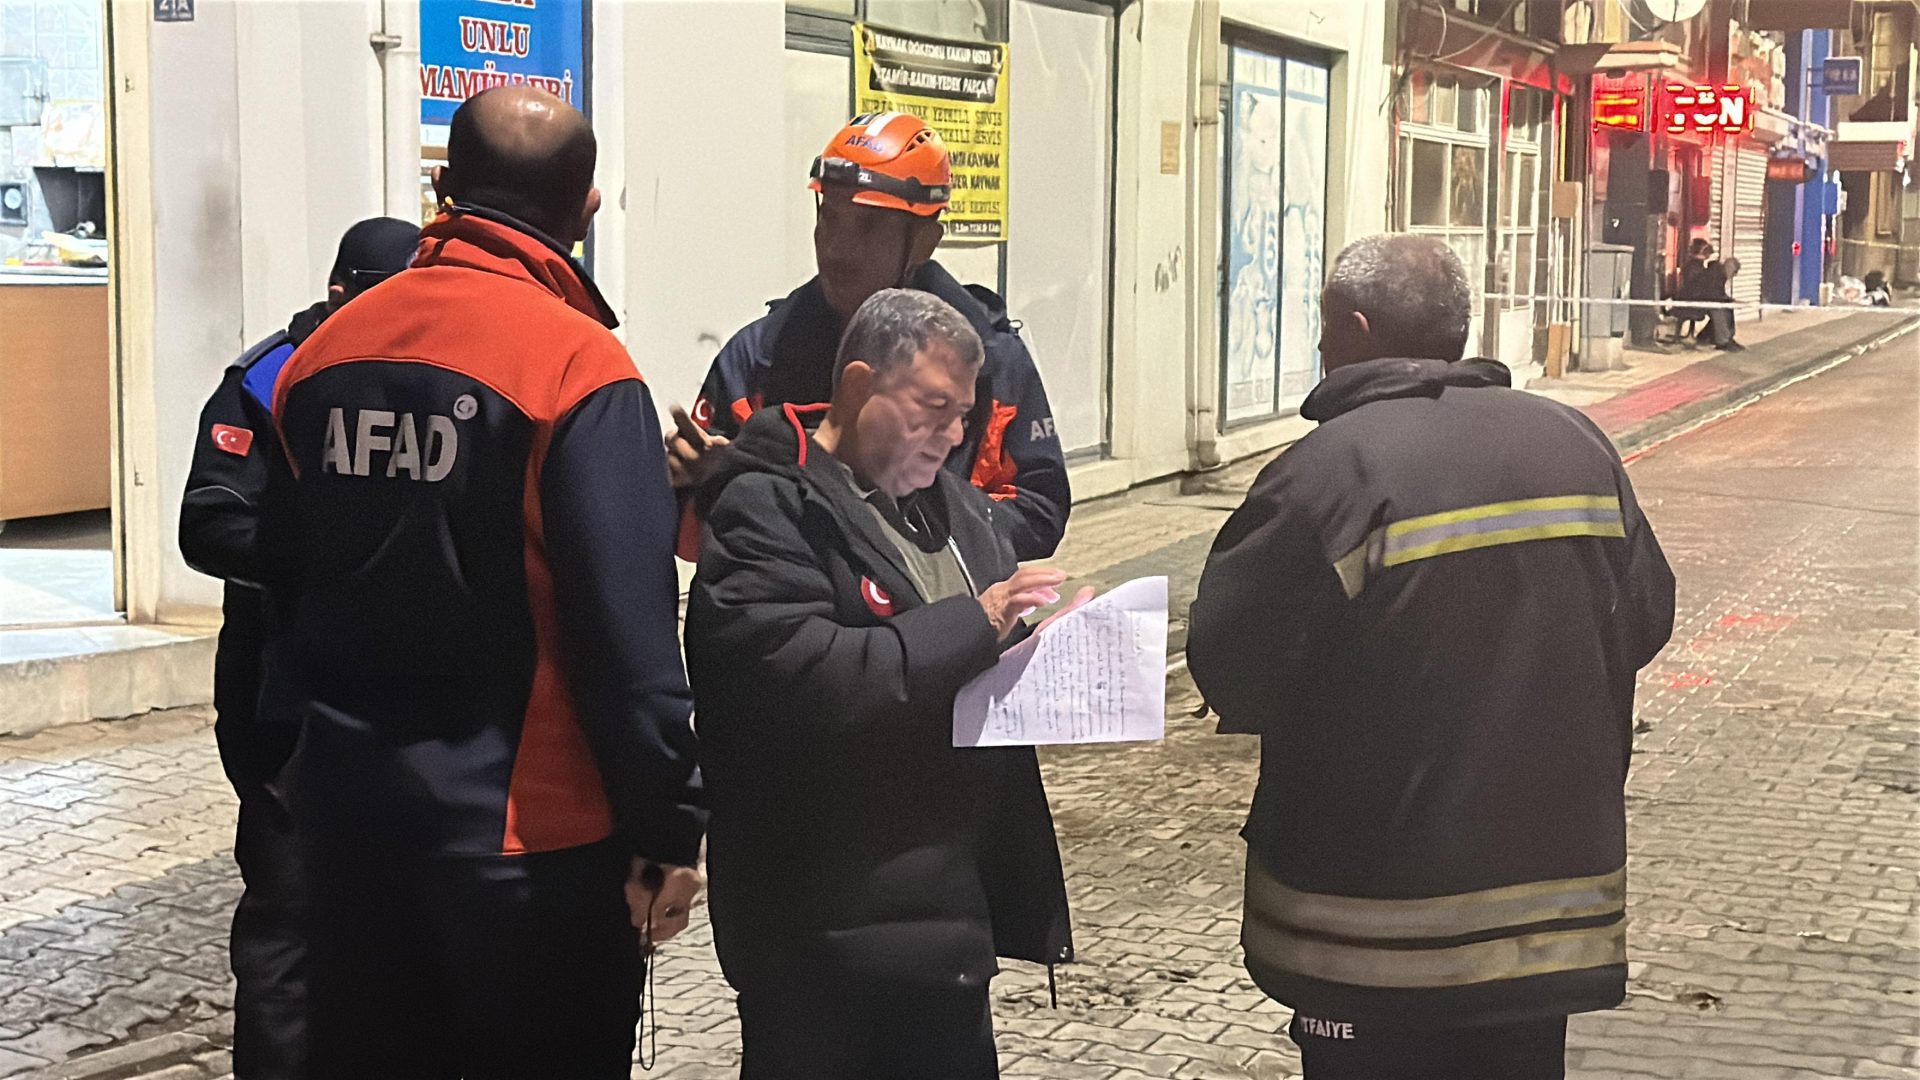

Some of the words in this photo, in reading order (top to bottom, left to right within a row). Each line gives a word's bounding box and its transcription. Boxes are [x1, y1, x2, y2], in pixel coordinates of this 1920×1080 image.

[460, 18, 530, 56] UNLU
[322, 407, 458, 482] AFAD
[1030, 417, 1054, 442] AF
